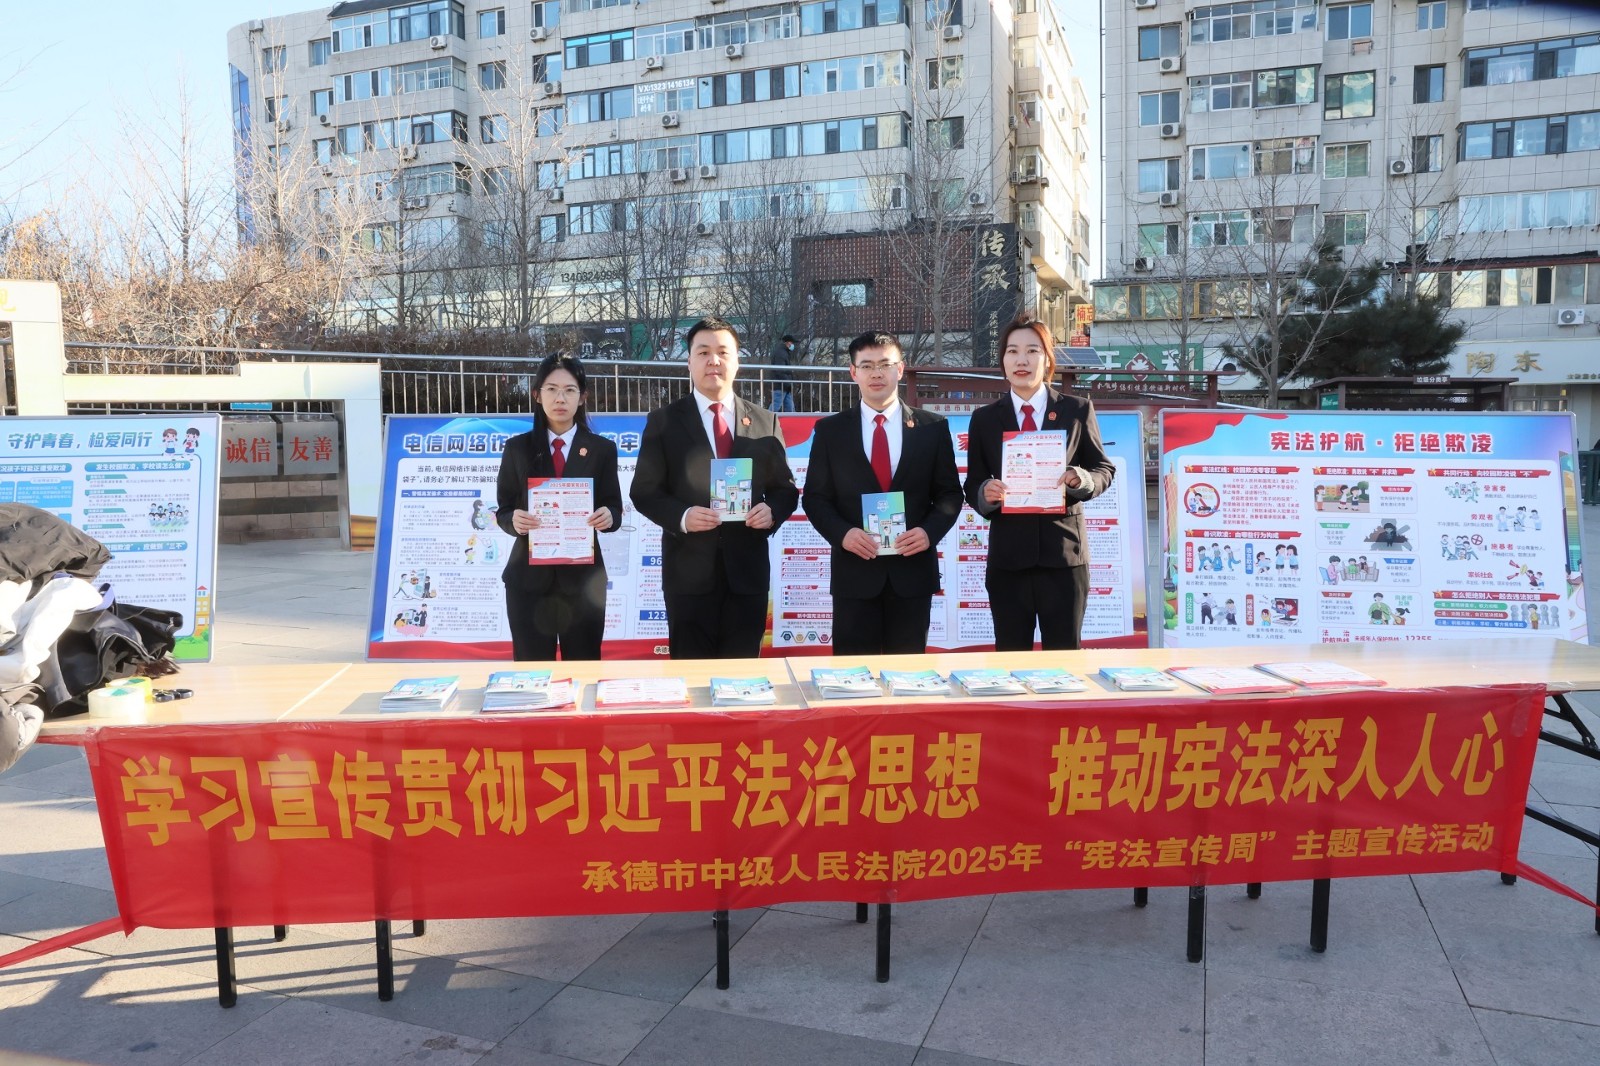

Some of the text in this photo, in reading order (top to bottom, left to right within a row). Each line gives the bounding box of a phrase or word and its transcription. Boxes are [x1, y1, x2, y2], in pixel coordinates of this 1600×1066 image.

[980, 230, 1011, 290] 传承
[8, 431, 153, 449] 守护青春，检爱同行
[225, 437, 271, 464] 诚信
[289, 436, 333, 462] 友善
[404, 433, 510, 453] 电信网络诈
[1270, 431, 1493, 453] 宪法护航·拒绝欺凌
[655, 646, 669, 654] 承德
[121, 711, 1504, 847] 学习宣传贯彻习近平法治思想 推动宪法深入人心
[582, 820, 1494, 893] 承德市中级人民法院2025年 “宪法宣传周” 主题宣传活动
